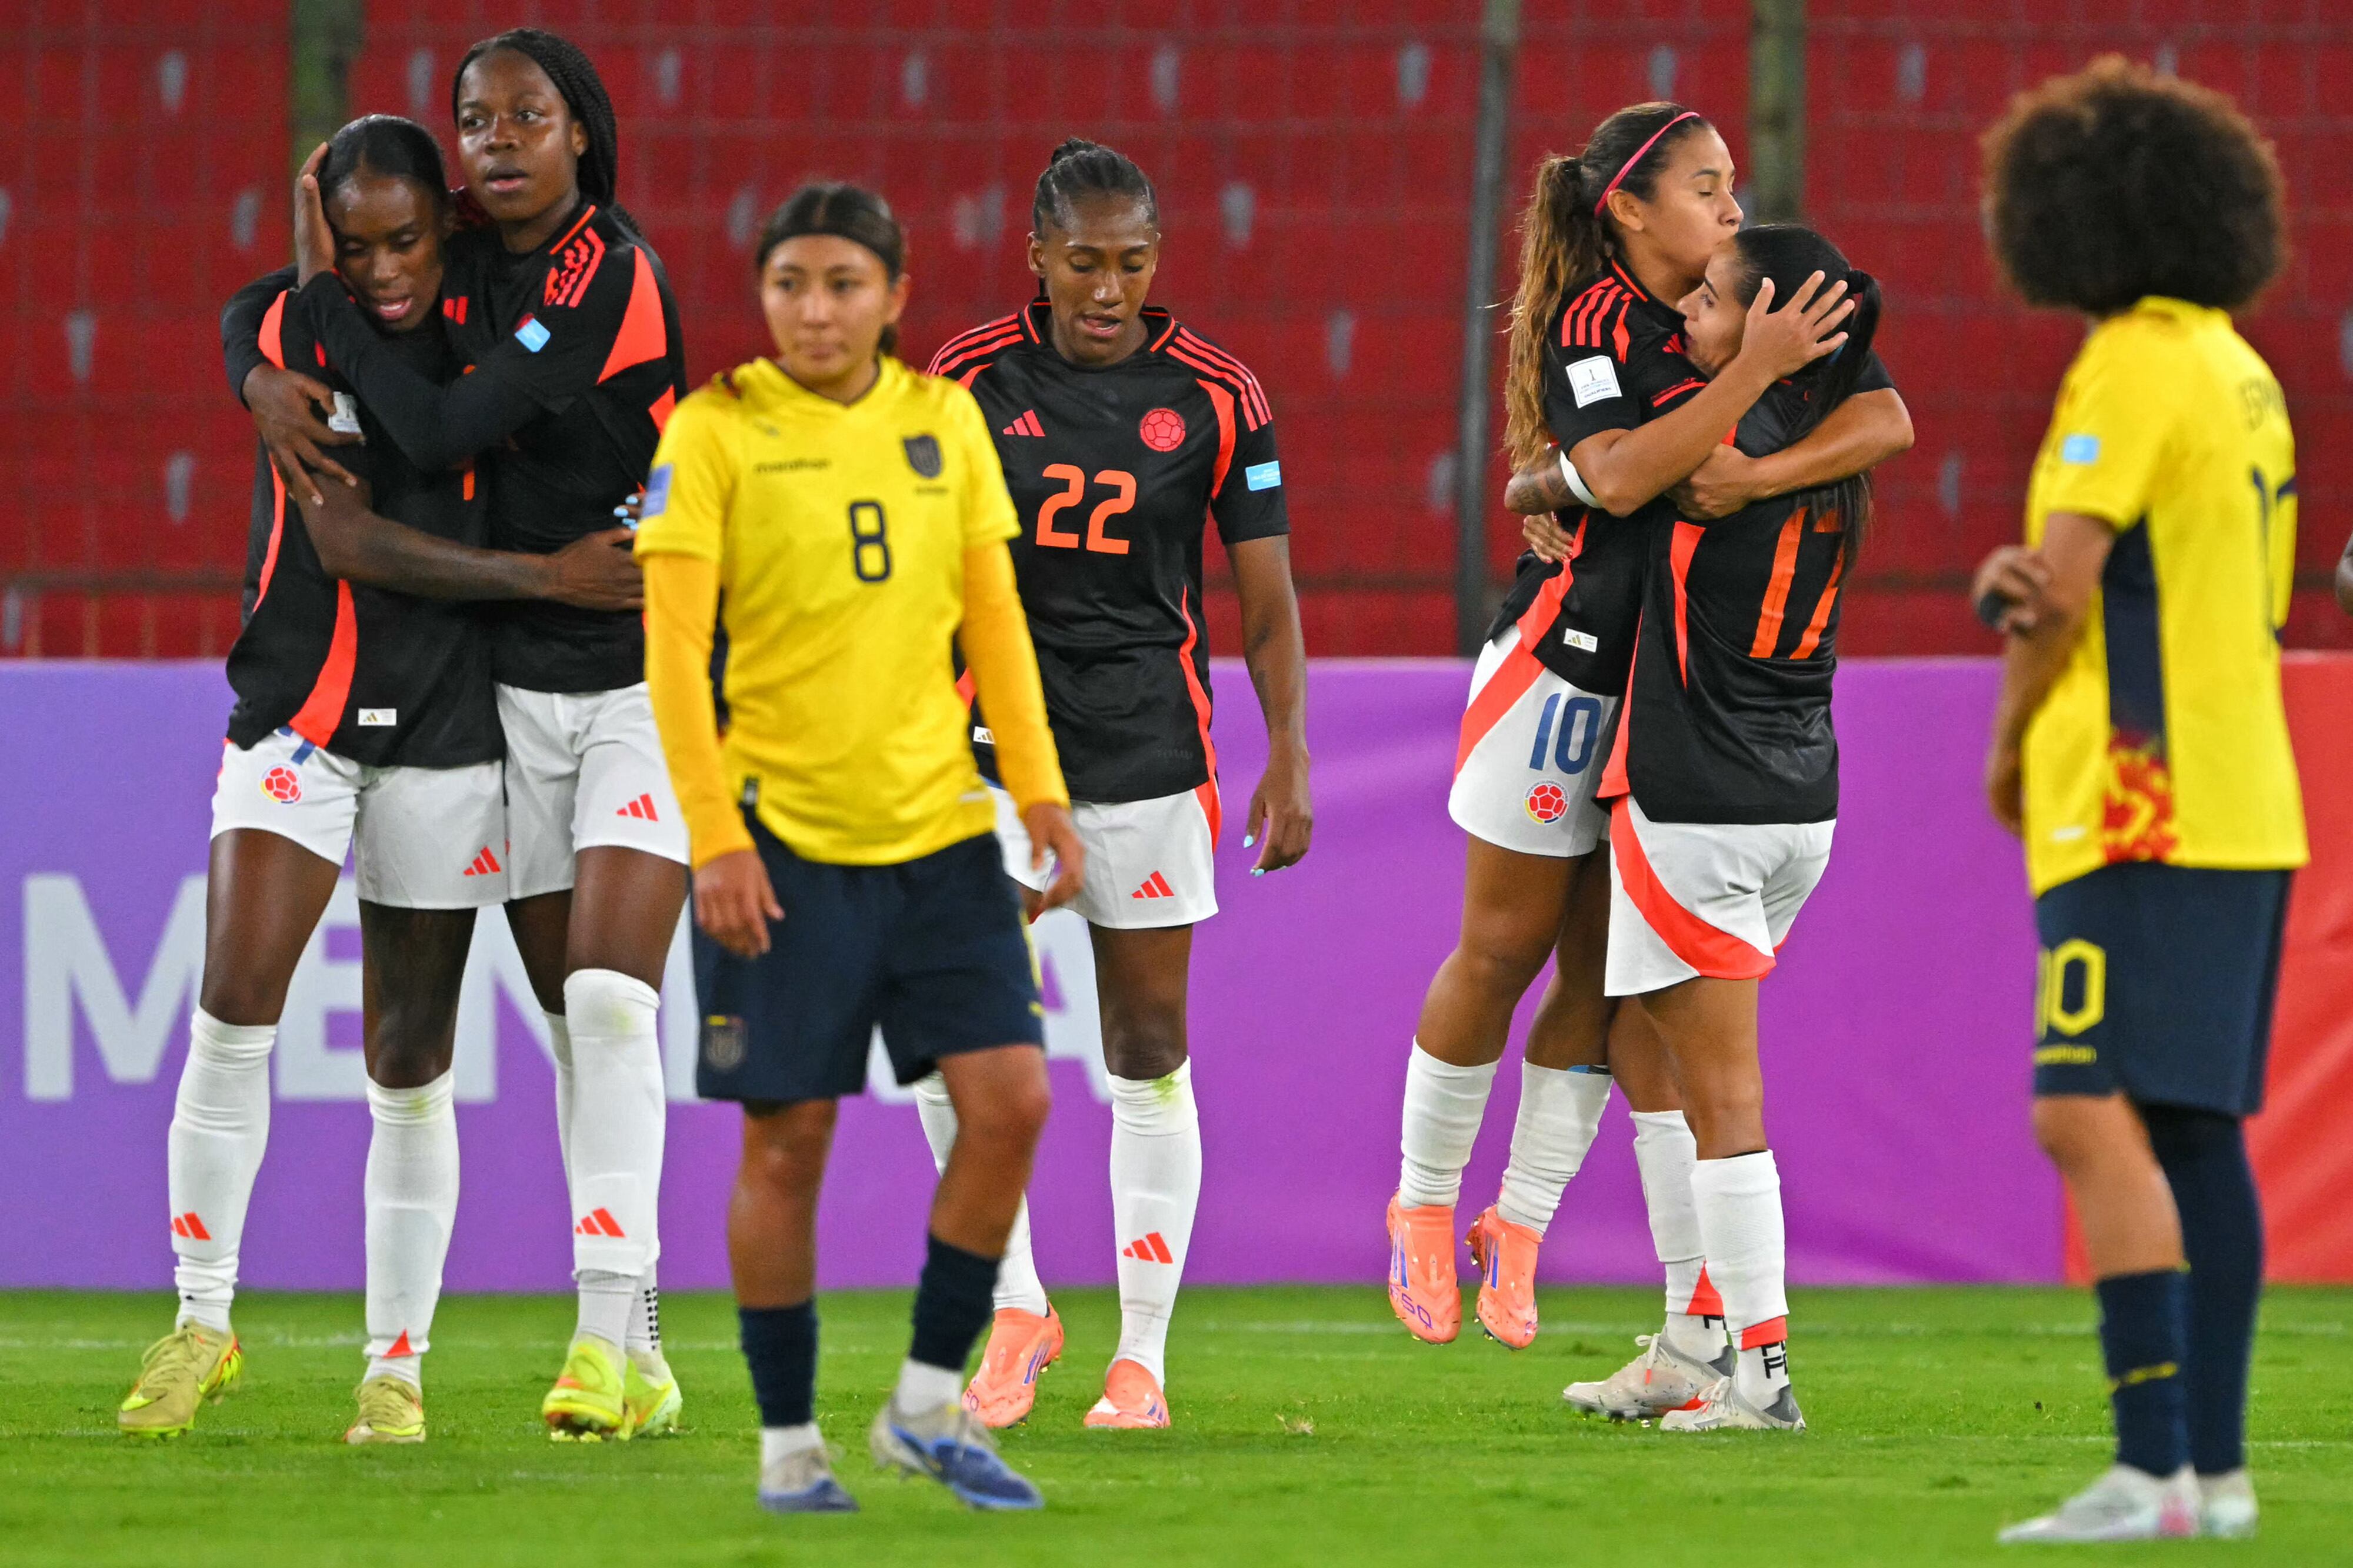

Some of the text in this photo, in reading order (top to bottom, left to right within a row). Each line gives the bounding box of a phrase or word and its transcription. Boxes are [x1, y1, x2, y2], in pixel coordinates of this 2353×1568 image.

[848, 499, 892, 582] 8
[1036, 463, 1136, 555] 22
[1749, 505, 1847, 659] 17
[1529, 693, 1601, 775] 10
[2034, 938, 2107, 1040] 10
